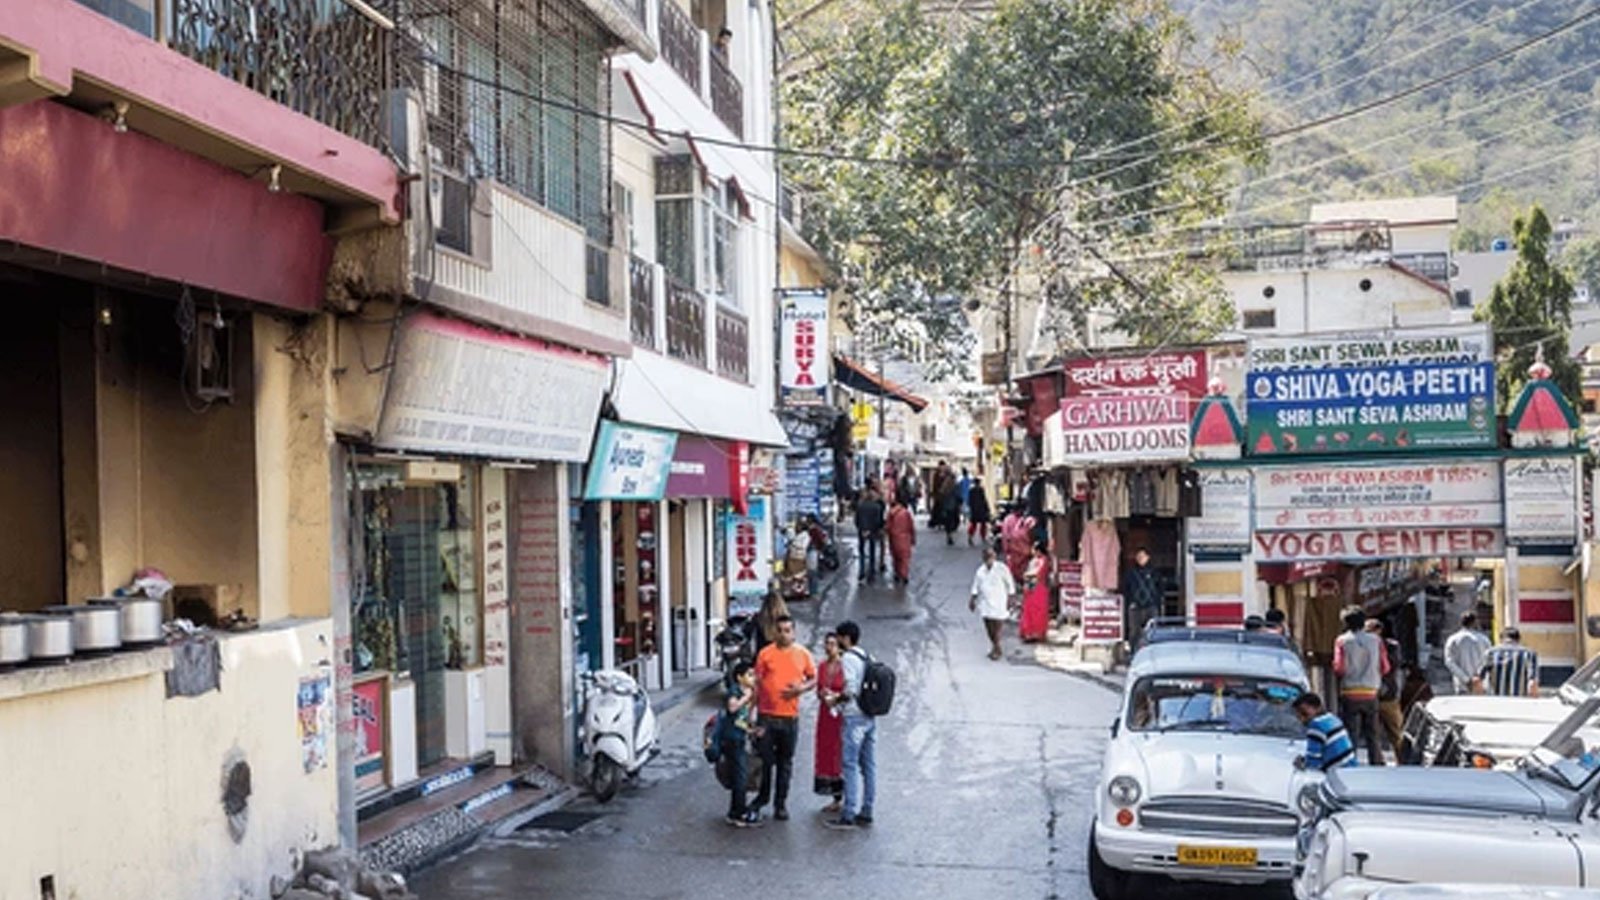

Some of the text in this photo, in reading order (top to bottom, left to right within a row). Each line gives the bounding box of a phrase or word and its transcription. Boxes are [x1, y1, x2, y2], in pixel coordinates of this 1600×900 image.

[794, 321, 816, 386] SURYA
[1290, 345, 1332, 362] SANT
[1337, 341, 1387, 360] SEWA
[1391, 337, 1458, 356] ASHRAM
[1275, 368, 1486, 400] SHIVA YOGA PEETH
[1065, 401, 1183, 426] GARHWAL
[1277, 402, 1468, 427] SHRI SANT SEVA ASHRAM
[1065, 430, 1187, 453] HANDLOOMS
[736, 523, 758, 582] SURYA
[1254, 529, 1496, 559] YOGA CENTER
